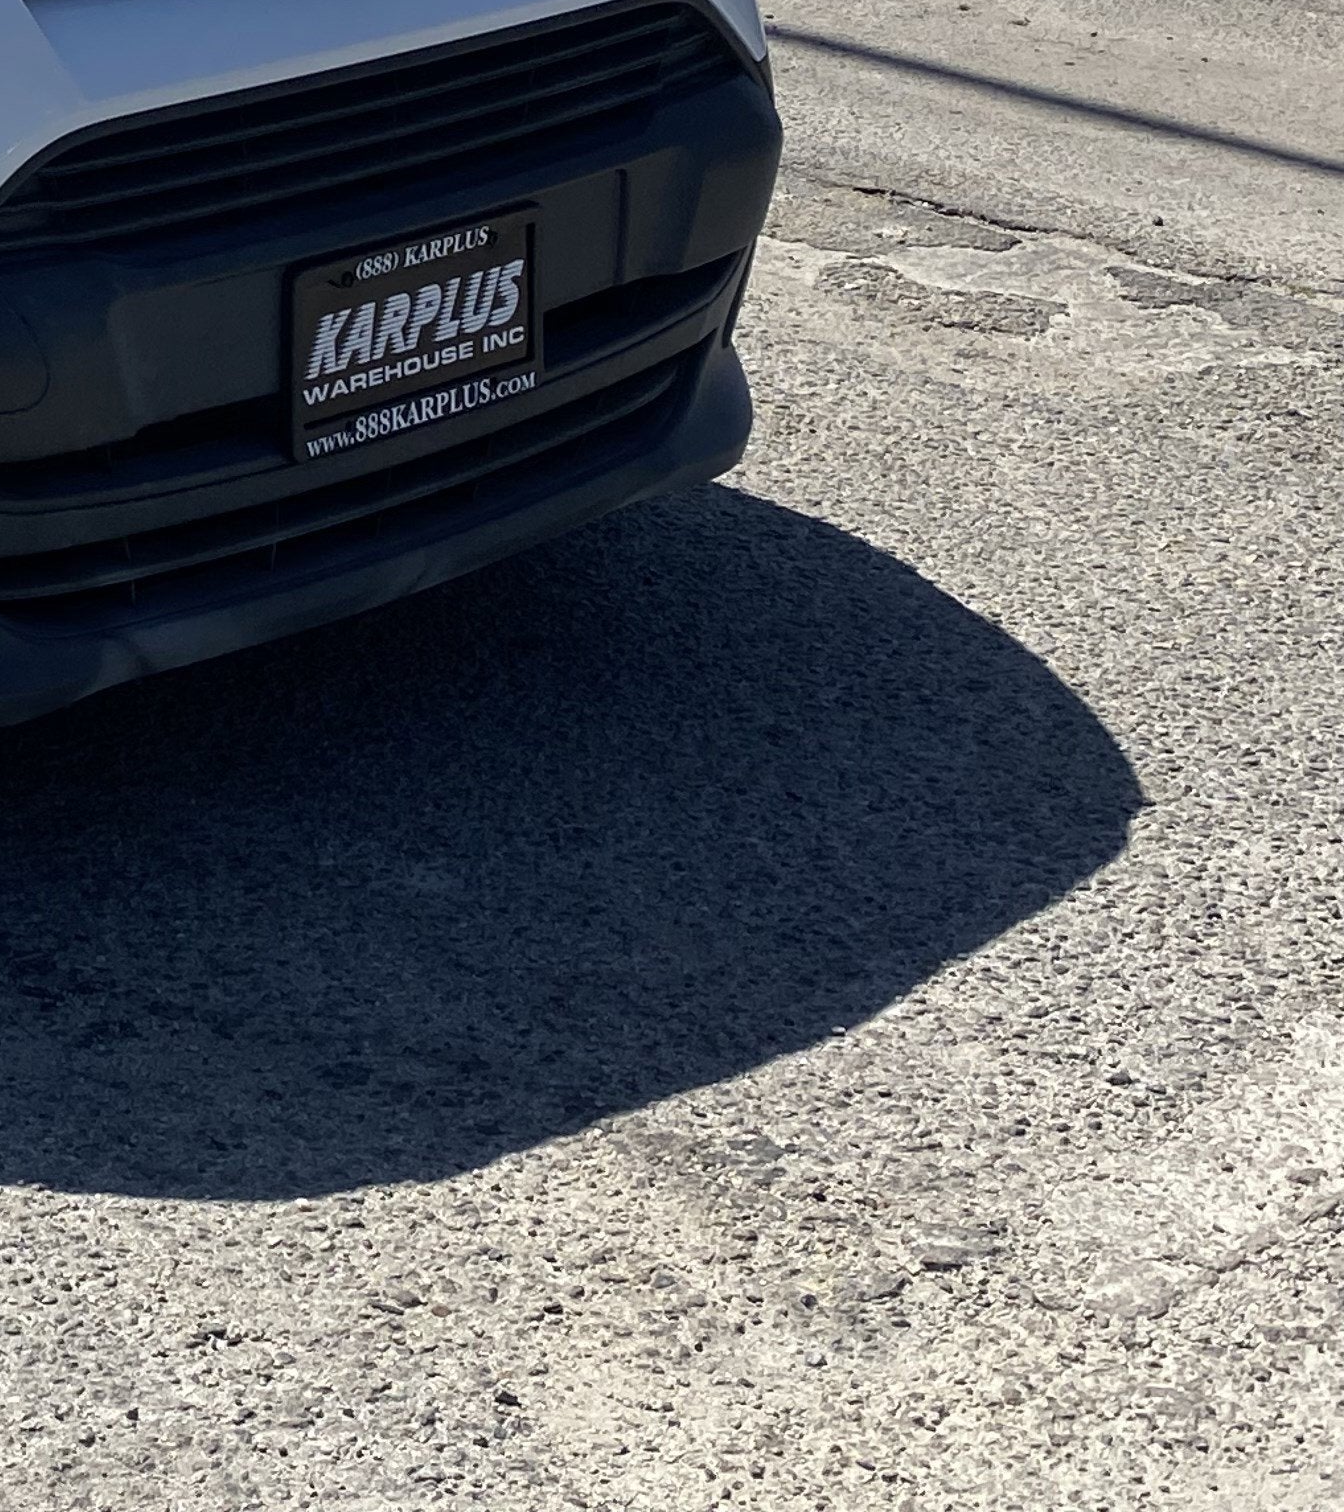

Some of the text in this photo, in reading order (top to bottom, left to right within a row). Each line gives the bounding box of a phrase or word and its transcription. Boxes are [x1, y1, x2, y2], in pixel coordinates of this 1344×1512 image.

[355, 226, 490, 281] (888) KARPLUS
[304, 259, 525, 381] KARPLUS
[303, 326, 525, 406] WAREHOUSE INC
